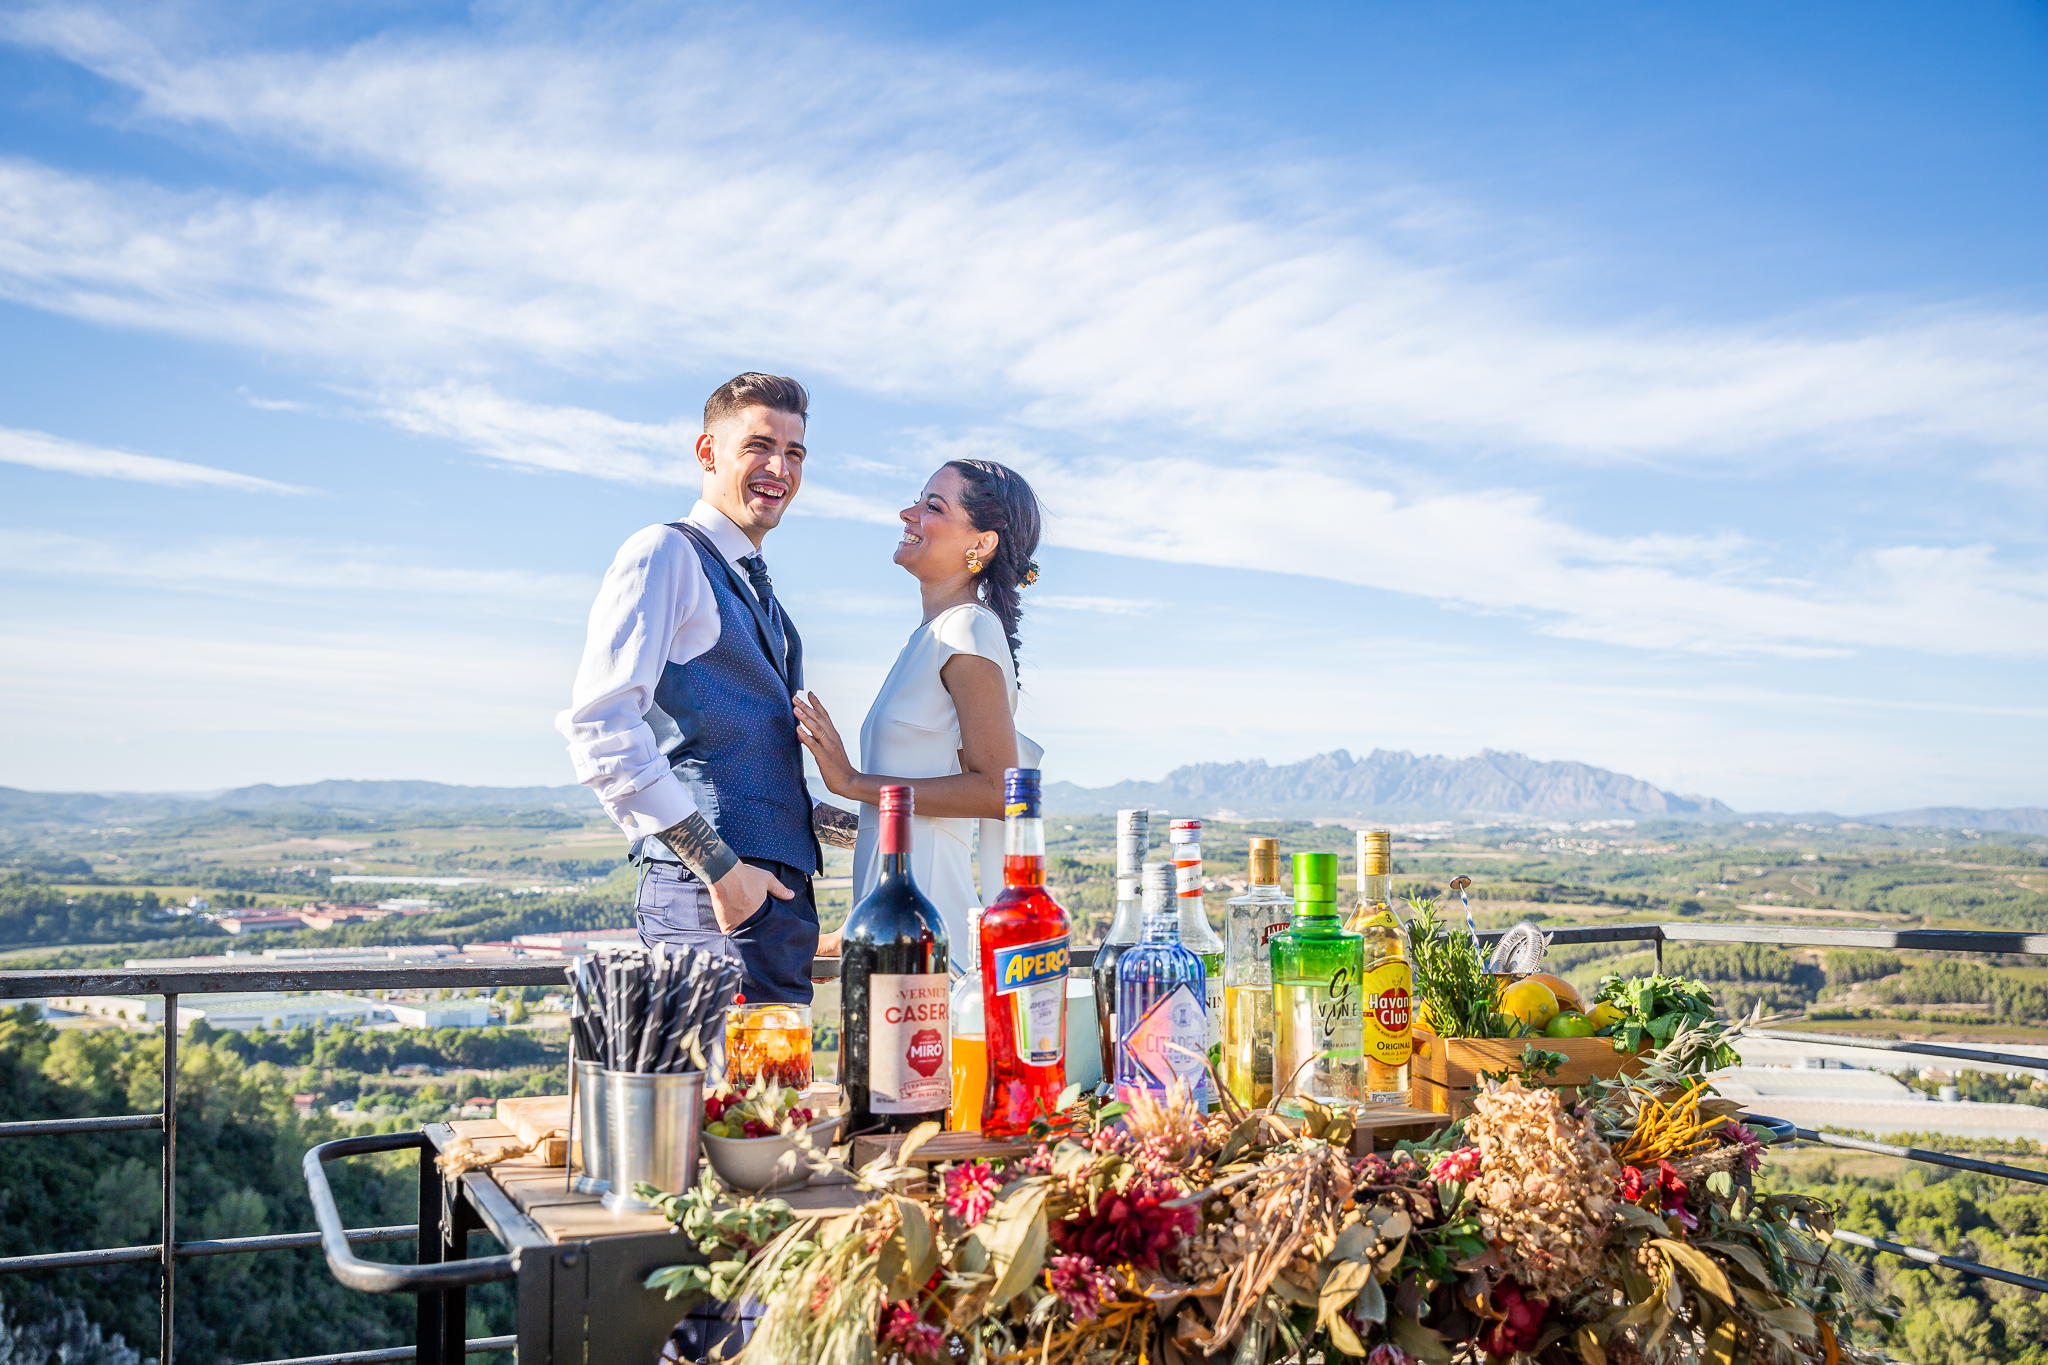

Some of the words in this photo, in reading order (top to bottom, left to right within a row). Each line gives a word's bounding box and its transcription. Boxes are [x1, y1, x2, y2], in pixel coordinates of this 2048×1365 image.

[1385, 913, 1392, 924] 3
[899, 987, 947, 1000] VERMUT
[1368, 993, 1411, 1010] Havan
[885, 1002, 950, 1025] CASER
[1318, 1003, 1358, 1018] VINE
[1380, 1009, 1409, 1026] Club
[911, 1040, 942, 1058] MIRÓ
[1376, 1041, 1410, 1051] ORIGINAL
